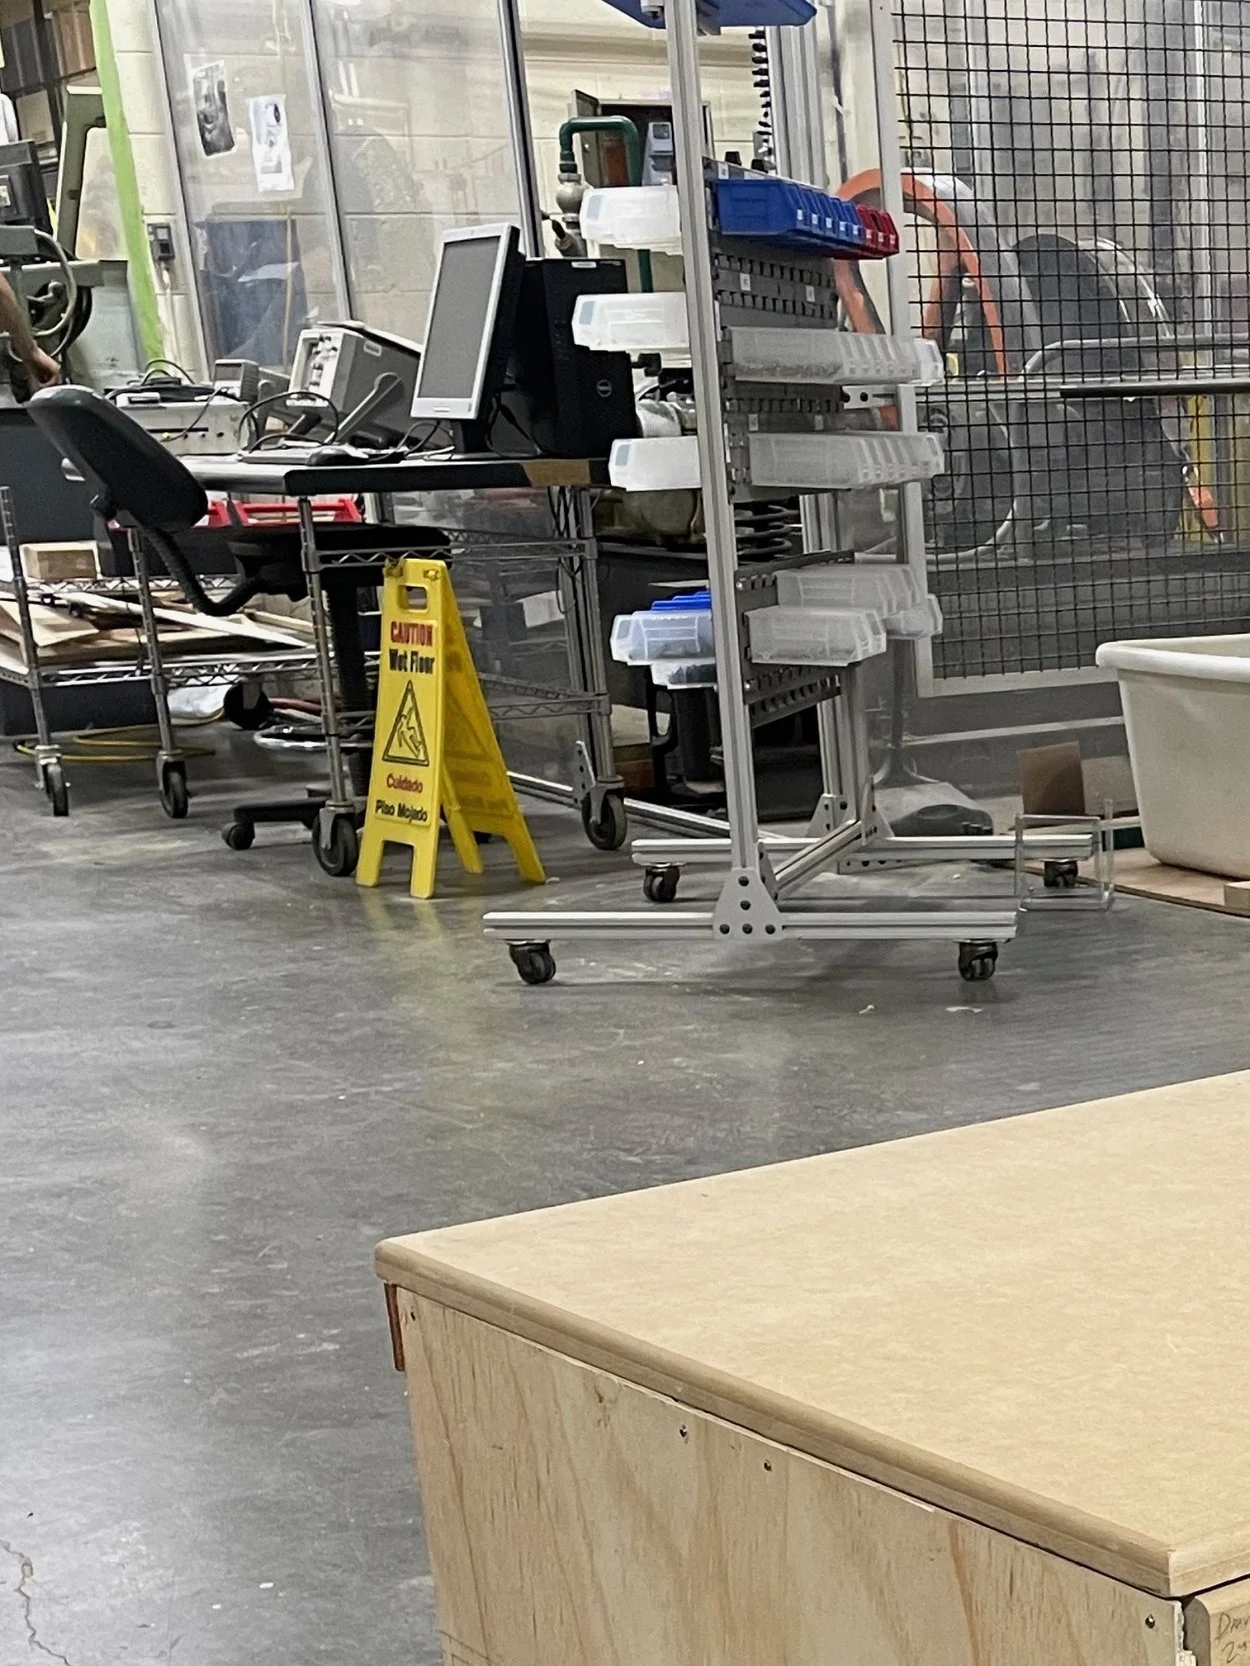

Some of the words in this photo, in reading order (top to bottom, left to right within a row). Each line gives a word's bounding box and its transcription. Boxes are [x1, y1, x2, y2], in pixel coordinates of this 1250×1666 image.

[391, 621, 433, 647] CAUTION
[389, 648, 408, 672] Wet
[410, 651, 435, 674] Floor
[386, 773, 423, 794] Cuidado
[375, 799, 395, 816] Piso
[397, 802, 428, 823] Mojado
